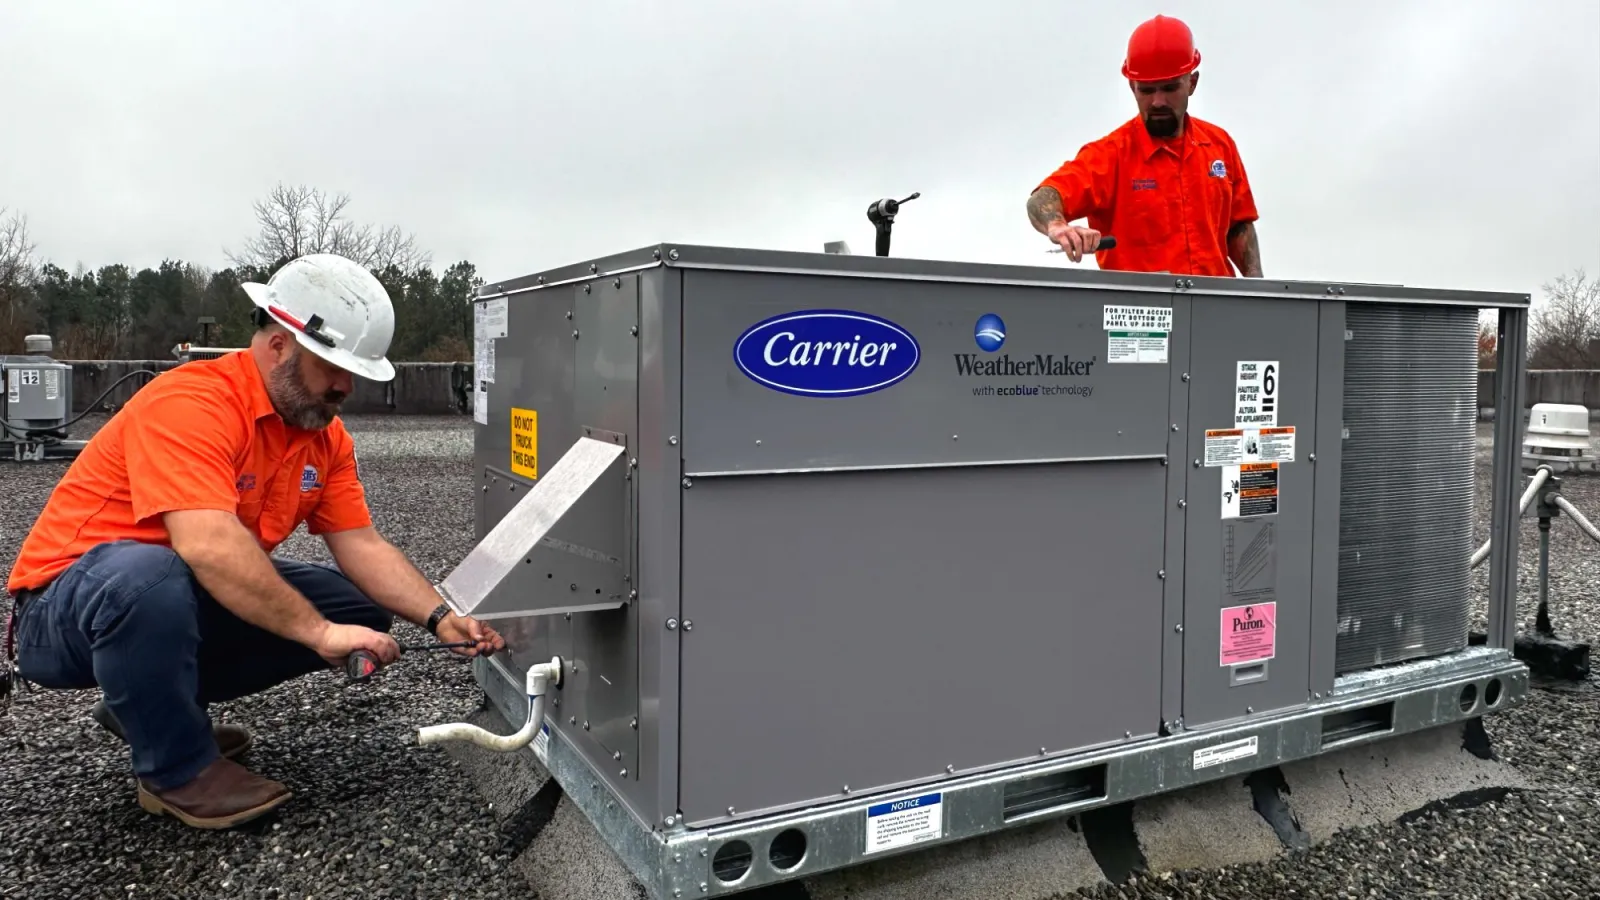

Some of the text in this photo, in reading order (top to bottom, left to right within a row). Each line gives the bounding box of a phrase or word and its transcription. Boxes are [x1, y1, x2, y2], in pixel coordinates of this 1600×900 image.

[763, 332, 897, 367] Carrier
[1241, 363, 1257, 371] STACK
[1240, 372, 1258, 380] HEIGHT
[1263, 364, 1275, 396] 6
[972, 385, 995, 396] with
[1042, 384, 1094, 397] technology
[1237, 385, 1260, 393] HAUTEUR
[1247, 393, 1257, 401] PILE
[1239, 406, 1257, 414] ALTURA
[514, 415, 533, 432] DO NOT
[1236, 415, 1242, 423] DE
[515, 433, 532, 450] TRUCK
[513, 450, 535, 469] THIS END
[1233, 618, 1263, 632] Puron
[890, 798, 920, 811] NOTICE
